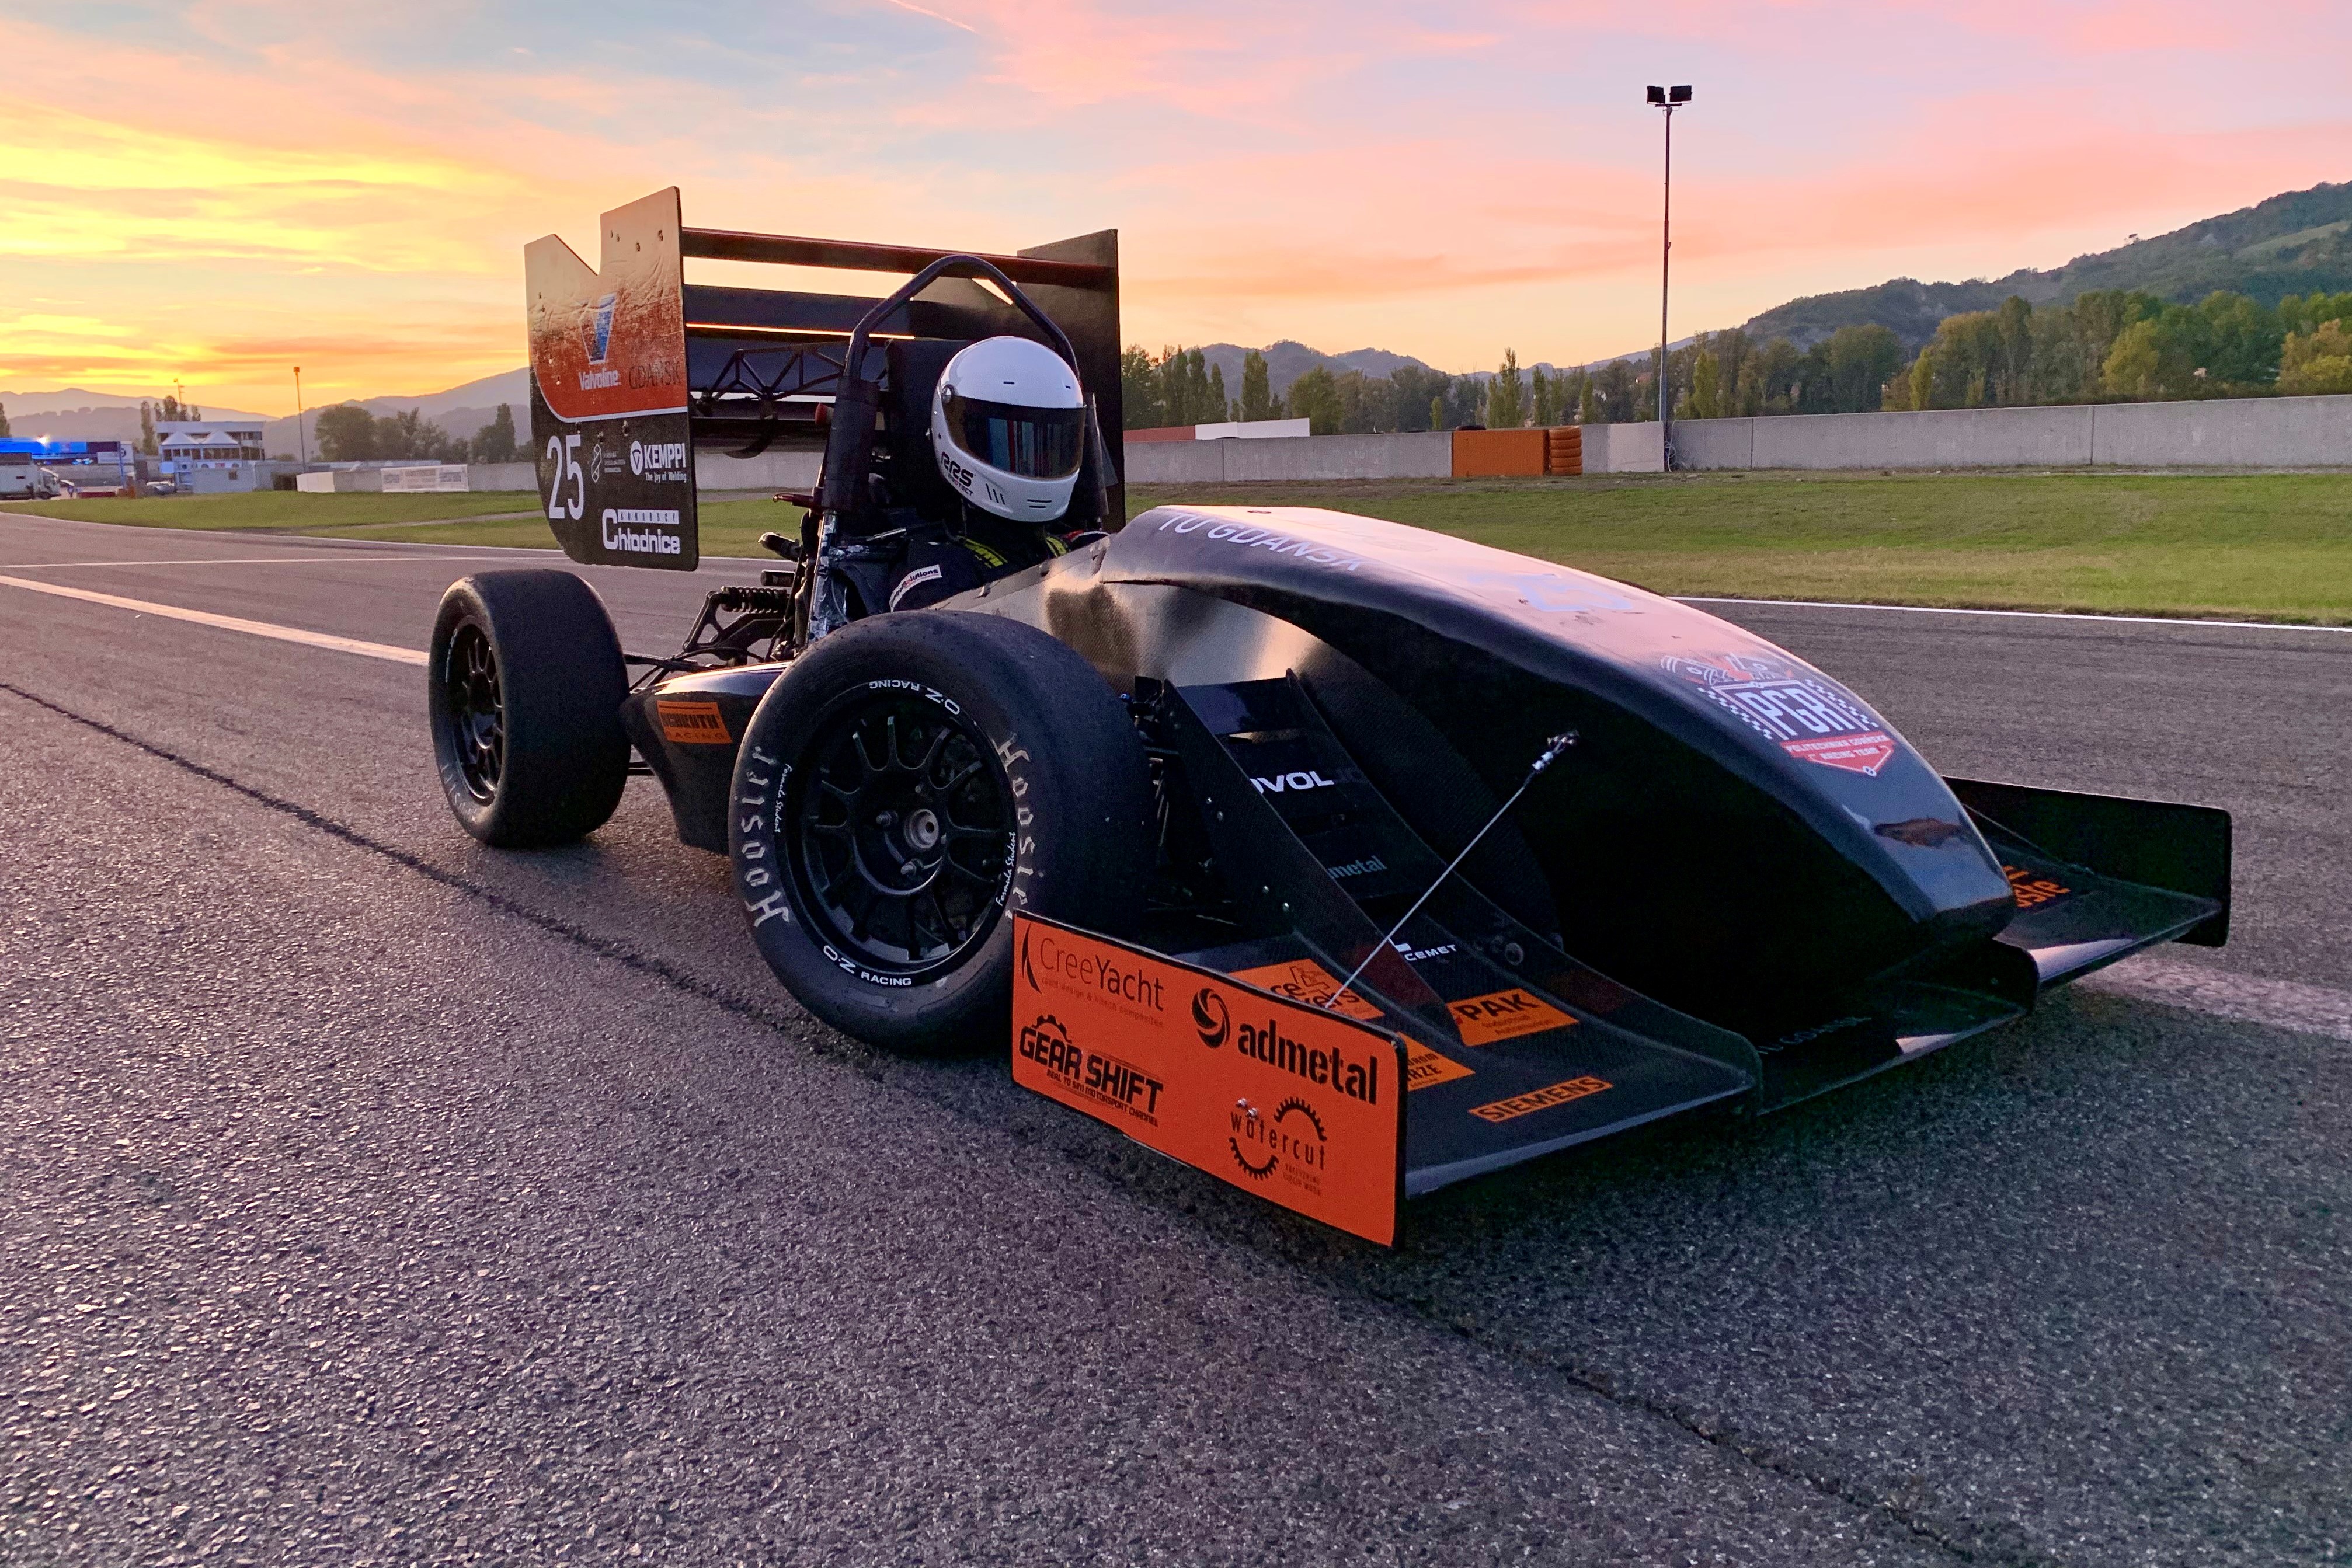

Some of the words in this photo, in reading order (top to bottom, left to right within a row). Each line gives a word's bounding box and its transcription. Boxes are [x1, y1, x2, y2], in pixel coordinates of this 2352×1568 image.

[579, 368, 620, 391] Valvoline
[643, 443, 686, 469] KEMPPI
[941, 451, 974, 487] RRS
[546, 434, 584, 520] 25
[662, 471, 667, 481] of
[668, 471, 687, 483] Welding
[1158, 513, 1214, 534] TU
[869, 680, 920, 692] RACING
[778, 763, 793, 799] Formula
[774, 799, 784, 833] Student
[996, 869, 1012, 907] Formula
[1004, 832, 1016, 867] Student
[1404, 943, 1457, 962] CEMET
[861, 971, 912, 986] RACING
[1040, 937, 1164, 1011] CreeYacht
[1452, 994, 1540, 1021] PAK
[1019, 1026, 1083, 1080] GEAR
[1084, 1054, 1164, 1114] SHIFT
[1238, 1019, 1377, 1106] admetal
[1046, 1068, 1062, 1083] REAL
[1063, 1076, 1071, 1086] TO
[1085, 1086, 1129, 1113] MOTORSPORT
[1477, 1078, 1605, 1120] SIEMENS
[1230, 1111, 1327, 1171] watercut
